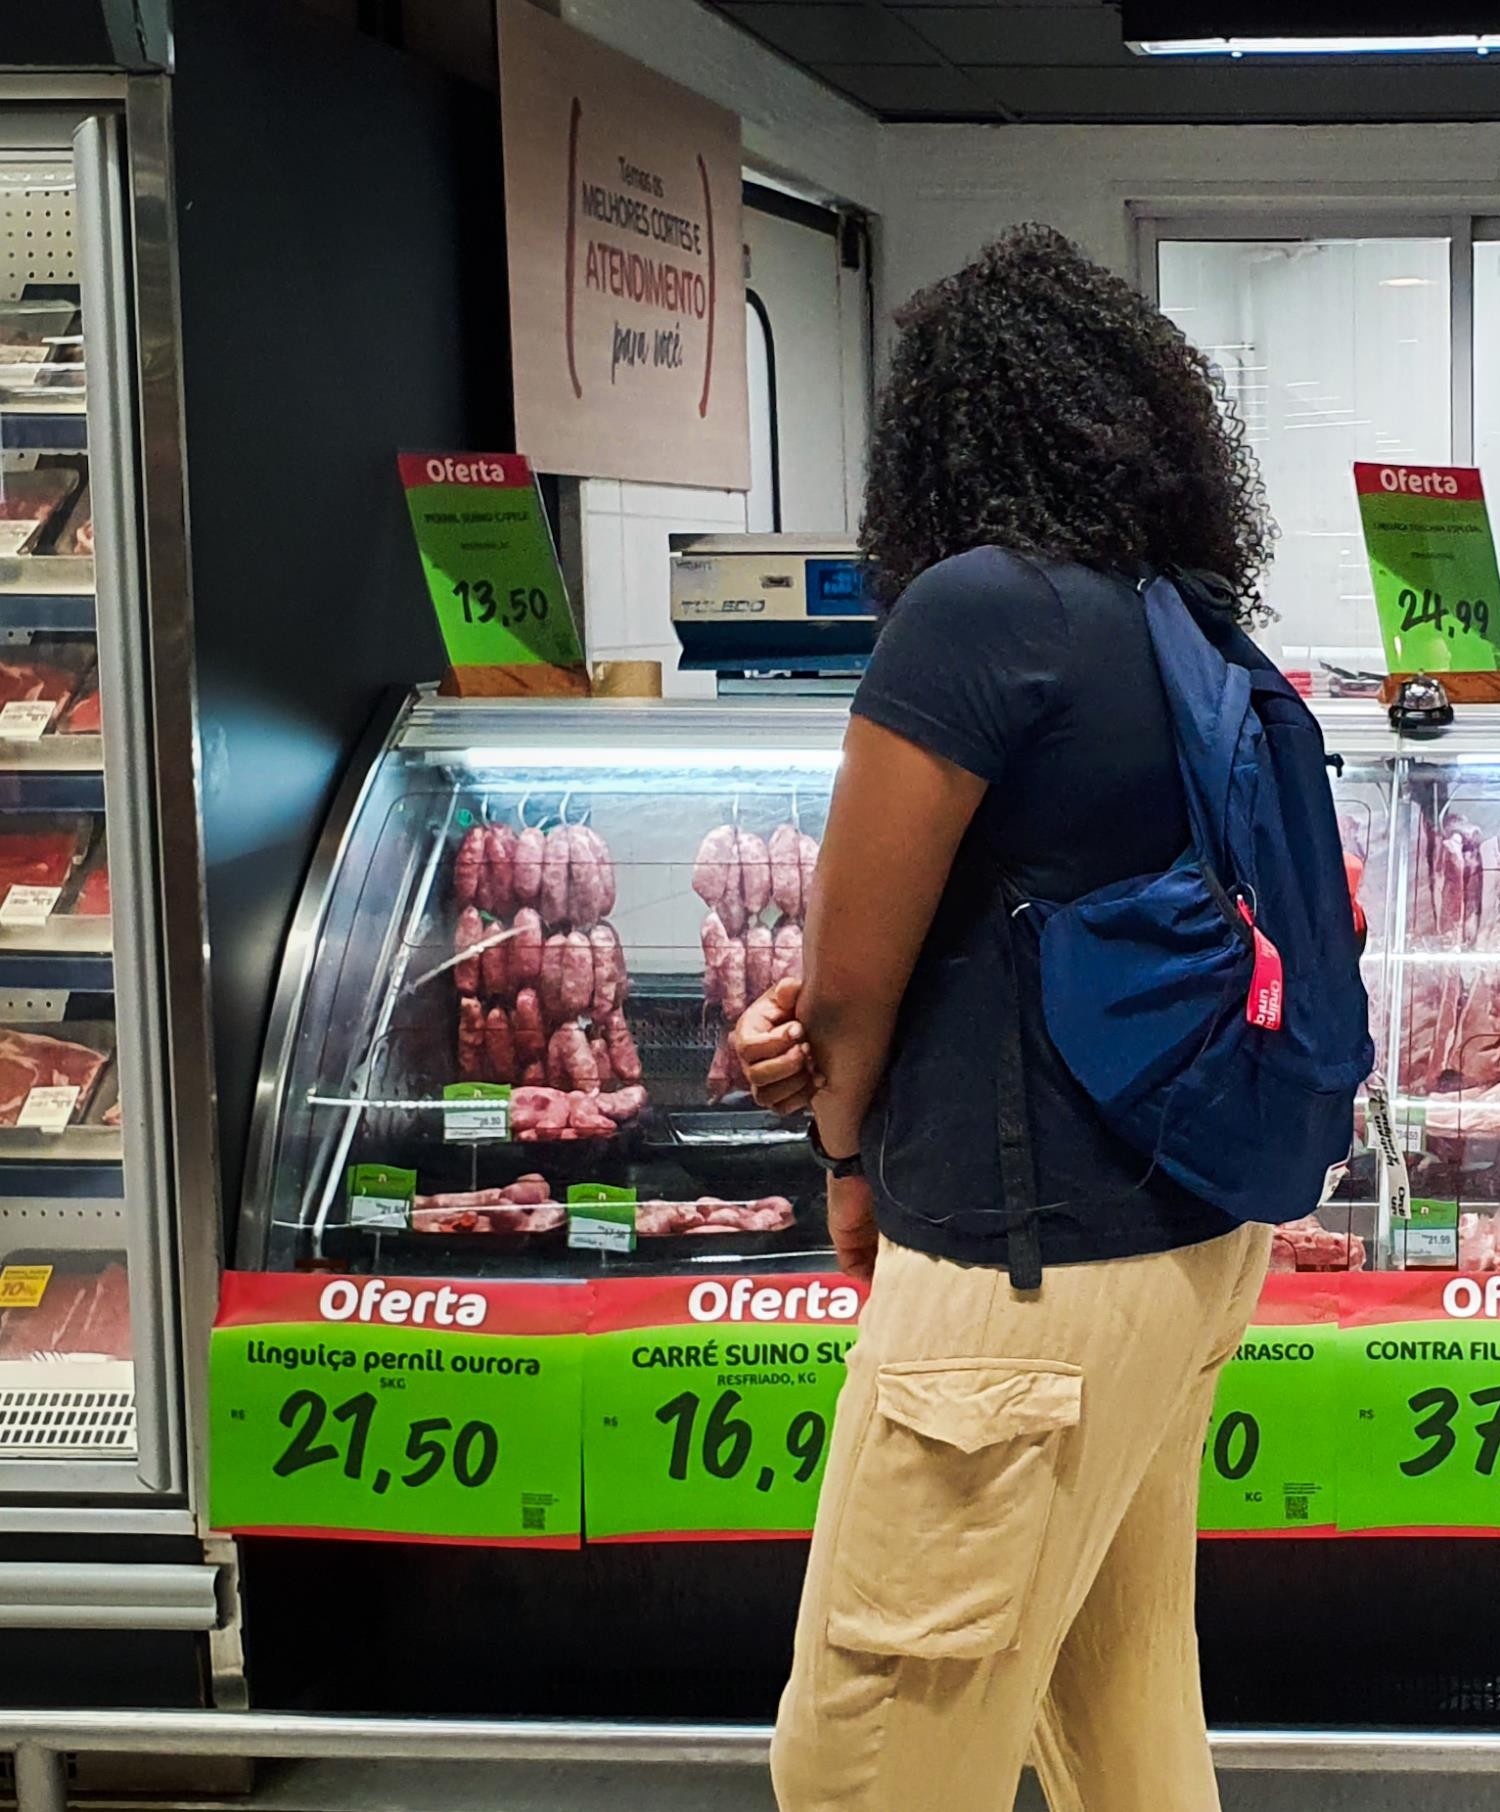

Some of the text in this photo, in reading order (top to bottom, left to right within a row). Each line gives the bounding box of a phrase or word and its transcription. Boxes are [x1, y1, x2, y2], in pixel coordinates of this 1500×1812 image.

[582, 180, 702, 255] MELHORES CORTES E
[586, 240, 706, 319] ATENDIMENTO
[426, 458, 505, 483] Oferta
[1379, 468, 1458, 494] Oferta
[452, 579, 549, 627] 13,50
[1398, 588, 1489, 638] 24,99
[319, 1279, 488, 1327] Oferta
[688, 1278, 859, 1322] Oferta
[247, 1340, 540, 1376] linguiça pernil ourora
[632, 1339, 856, 1368] CARRÉ SUINO SU
[1366, 1341, 1464, 1361] CONTRA
[717, 1372, 817, 1387] RESFRIADO, KG
[272, 1389, 499, 1495] 21,50
[1244, 1491, 1262, 1502] KG
